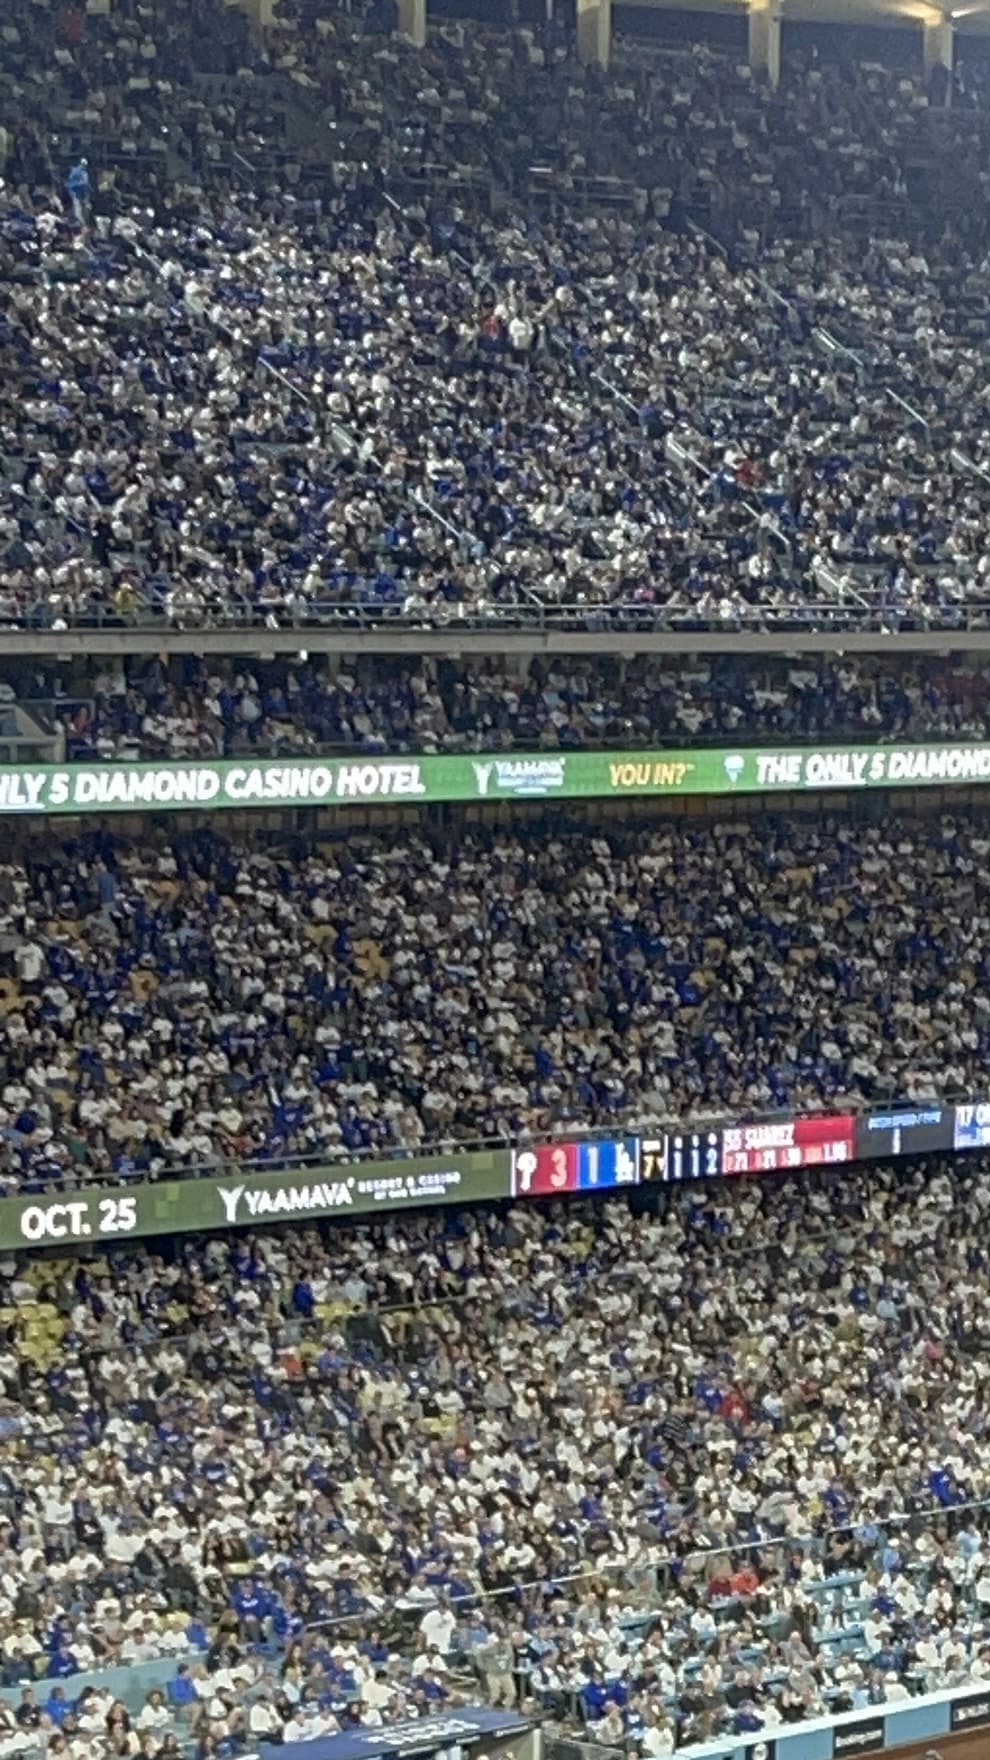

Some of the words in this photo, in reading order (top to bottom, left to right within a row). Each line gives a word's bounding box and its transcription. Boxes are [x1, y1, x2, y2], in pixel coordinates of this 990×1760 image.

[49, 773, 69, 804] 5
[75, 768, 220, 802] DIAMOND
[225, 766, 332, 799] CASINO
[336, 764, 426, 796] HOTEL
[609, 763, 651, 787] YOU
[756, 755, 801, 784] THE
[806, 753, 867, 784] ONLY
[869, 752, 886, 780] 5
[550, 1148, 568, 1188] 3
[588, 1146, 598, 1184] 1
[21, 1202, 91, 1240] OCT.
[99, 1197, 137, 1233] 25
